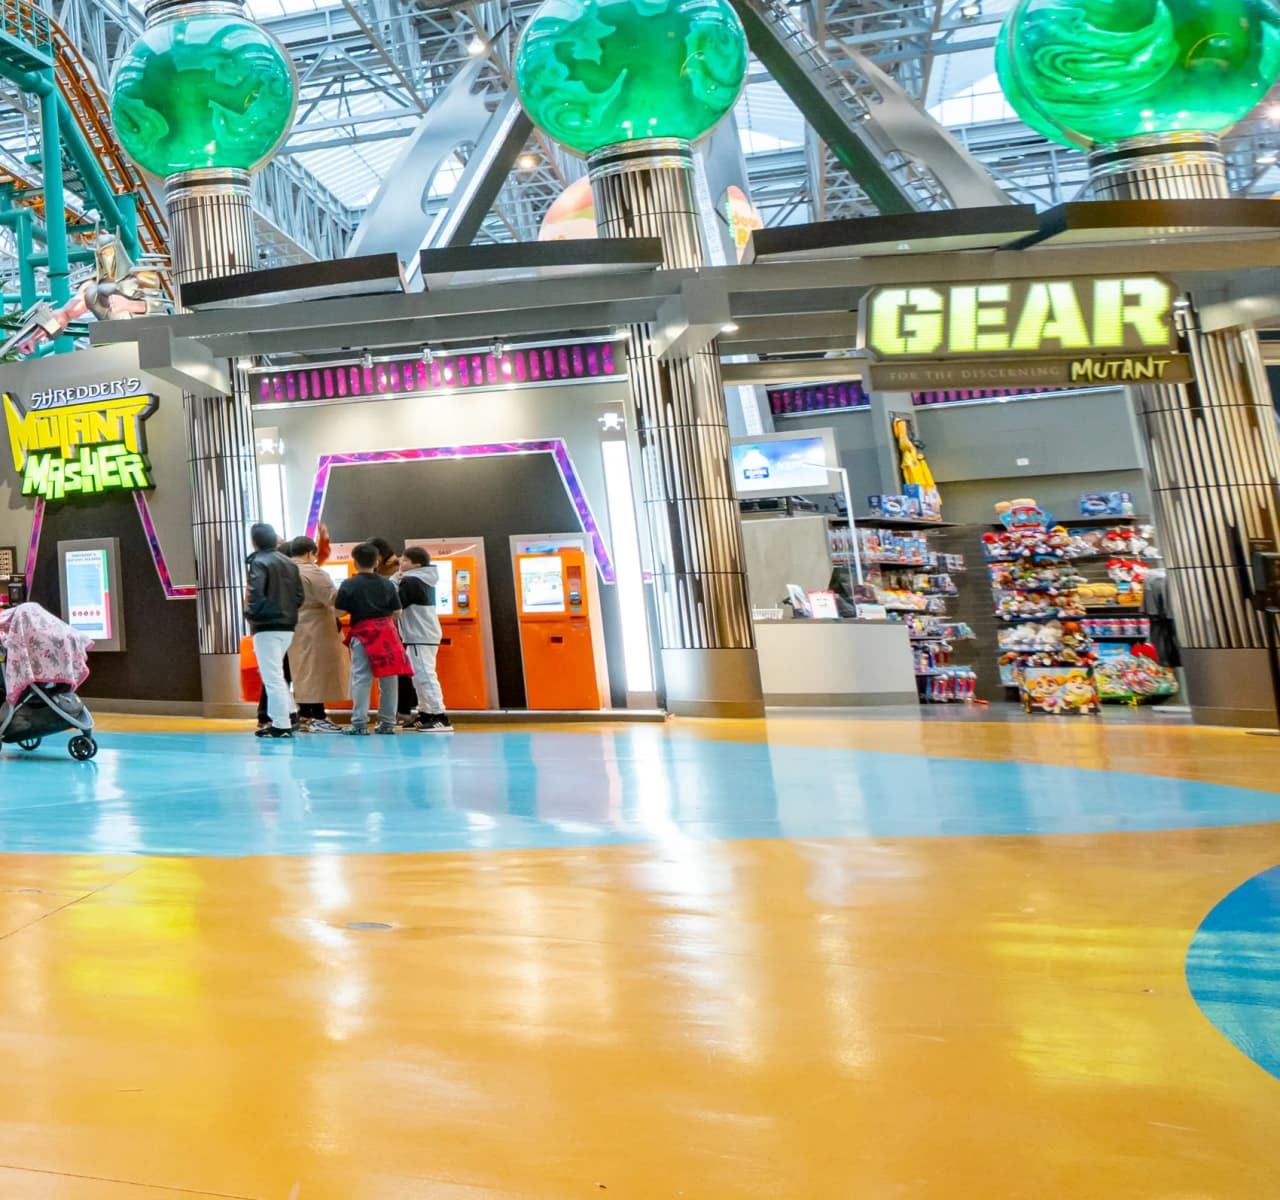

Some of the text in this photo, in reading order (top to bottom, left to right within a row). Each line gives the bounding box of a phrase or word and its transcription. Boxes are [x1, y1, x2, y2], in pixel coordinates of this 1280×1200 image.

[871, 277, 1171, 354] GEAR
[31, 377, 141, 409] SHREDDER'S
[961, 366, 1061, 379] DISCERNING
[1070, 355, 1171, 382] MUTANT
[2, 393, 152, 472] MUTANT
[22, 443, 148, 500] MASHER
